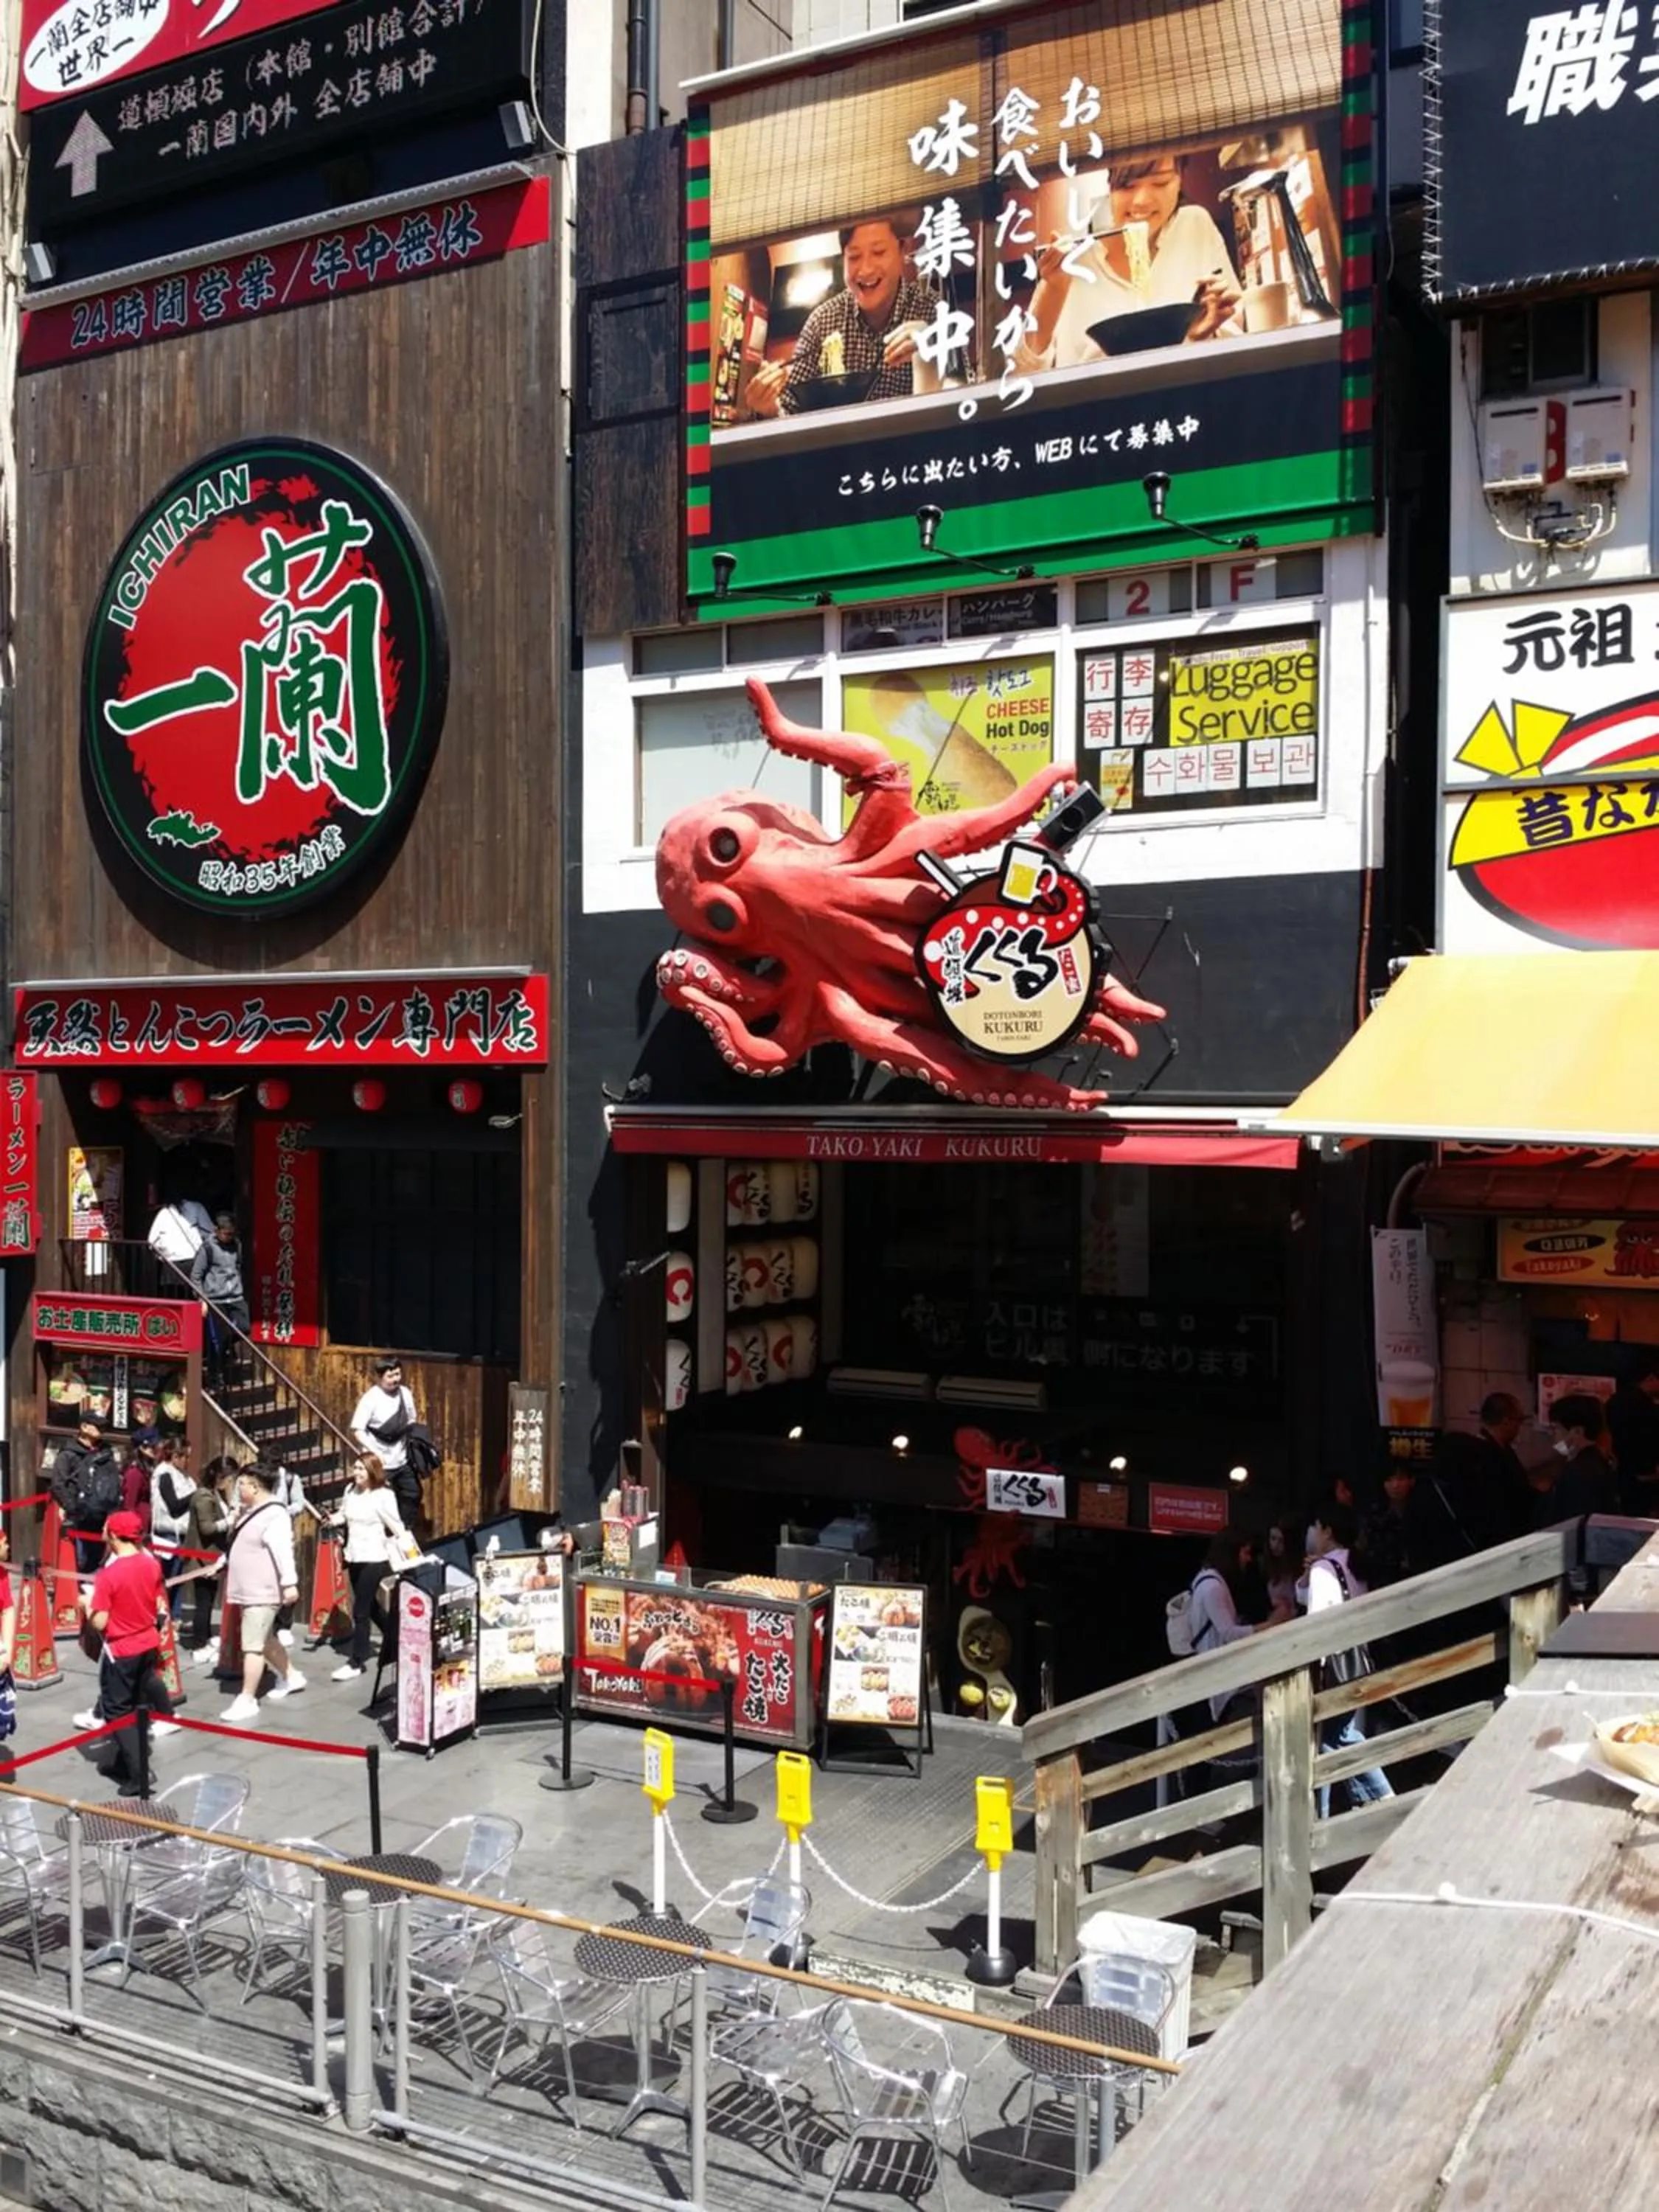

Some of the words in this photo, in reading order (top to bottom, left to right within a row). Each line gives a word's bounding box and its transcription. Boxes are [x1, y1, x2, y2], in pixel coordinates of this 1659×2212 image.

[58, 37, 134, 87] 世界一
[158, 91, 299, 160] 一蘭国内外
[313, 48, 438, 119] 全店舗中
[1059, 76, 1103, 284] おいしく
[991, 87, 1042, 411] 食べたいから
[108, 464, 251, 630] ICHIRAN
[1125, 580, 1151, 616] 2
[1230, 564, 1256, 602] F
[104, 499, 392, 815] 一蘭
[1503, 603, 1659, 674] 元祖
[1087, 657, 1152, 692] 行李
[1171, 652, 1318, 701] Luggage
[987, 698, 1050, 719] CHEESE
[987, 723, 1014, 738] Hot
[1019, 719, 1050, 737] Dog
[1086, 706, 1152, 739] 寄存
[1177, 699, 1315, 744] Service
[1146, 748, 1238, 787] 수화물
[1249, 741, 1315, 775] 보관
[198, 825, 346, 893] 昭和35年創業
[963, 928, 1060, 999] くくる
[24, 986, 539, 1057] 天然とんこつラーメン専門店
[983, 1010, 1043, 1020] DOTONBORI
[984, 1020, 1043, 1034] KUKURU
[3, 1077, 29, 1251] ラーメン一蘭
[945, 1137, 1043, 1157] KUKURU
[38, 1307, 140, 1335] お土産販売所
[1003, 1473, 1047, 1507] くくる
[590, 1615, 621, 1633] NO.1
[744, 1652, 766, 1722] たこ焼
[773, 1652, 791, 1703] 大たこ
